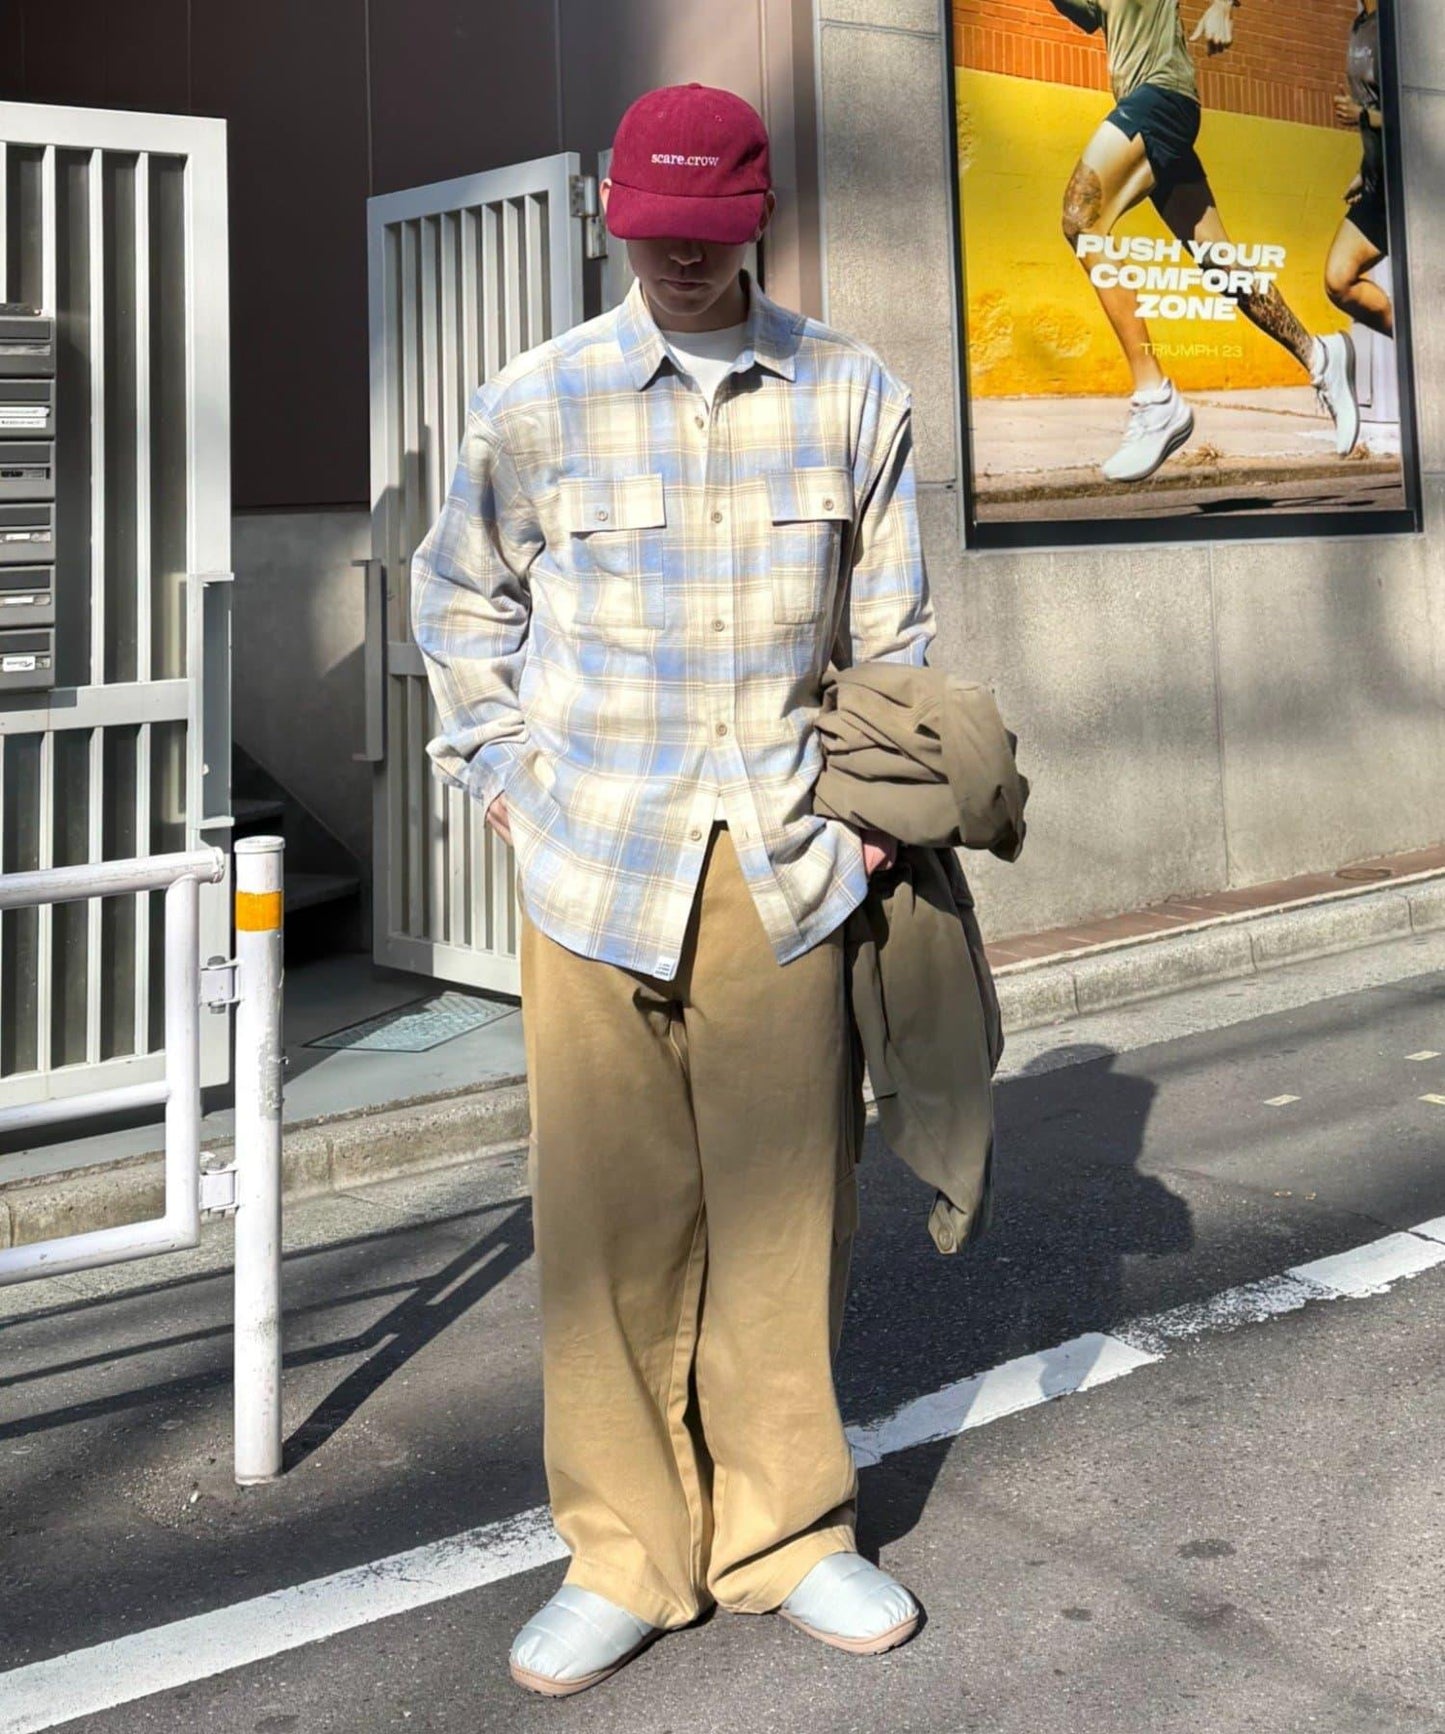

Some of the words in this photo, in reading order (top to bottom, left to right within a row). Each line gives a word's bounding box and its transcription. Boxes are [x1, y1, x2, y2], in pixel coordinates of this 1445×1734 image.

[651, 153, 719, 166] scare.crow
[1076, 234, 1182, 262] PUSH
[1187, 240, 1286, 267] YOUR
[1090, 264, 1278, 294] COMFORT
[1135, 294, 1238, 321] ZONE
[1140, 342, 1219, 357] TRIUMPH
[1222, 344, 1243, 358] 23
